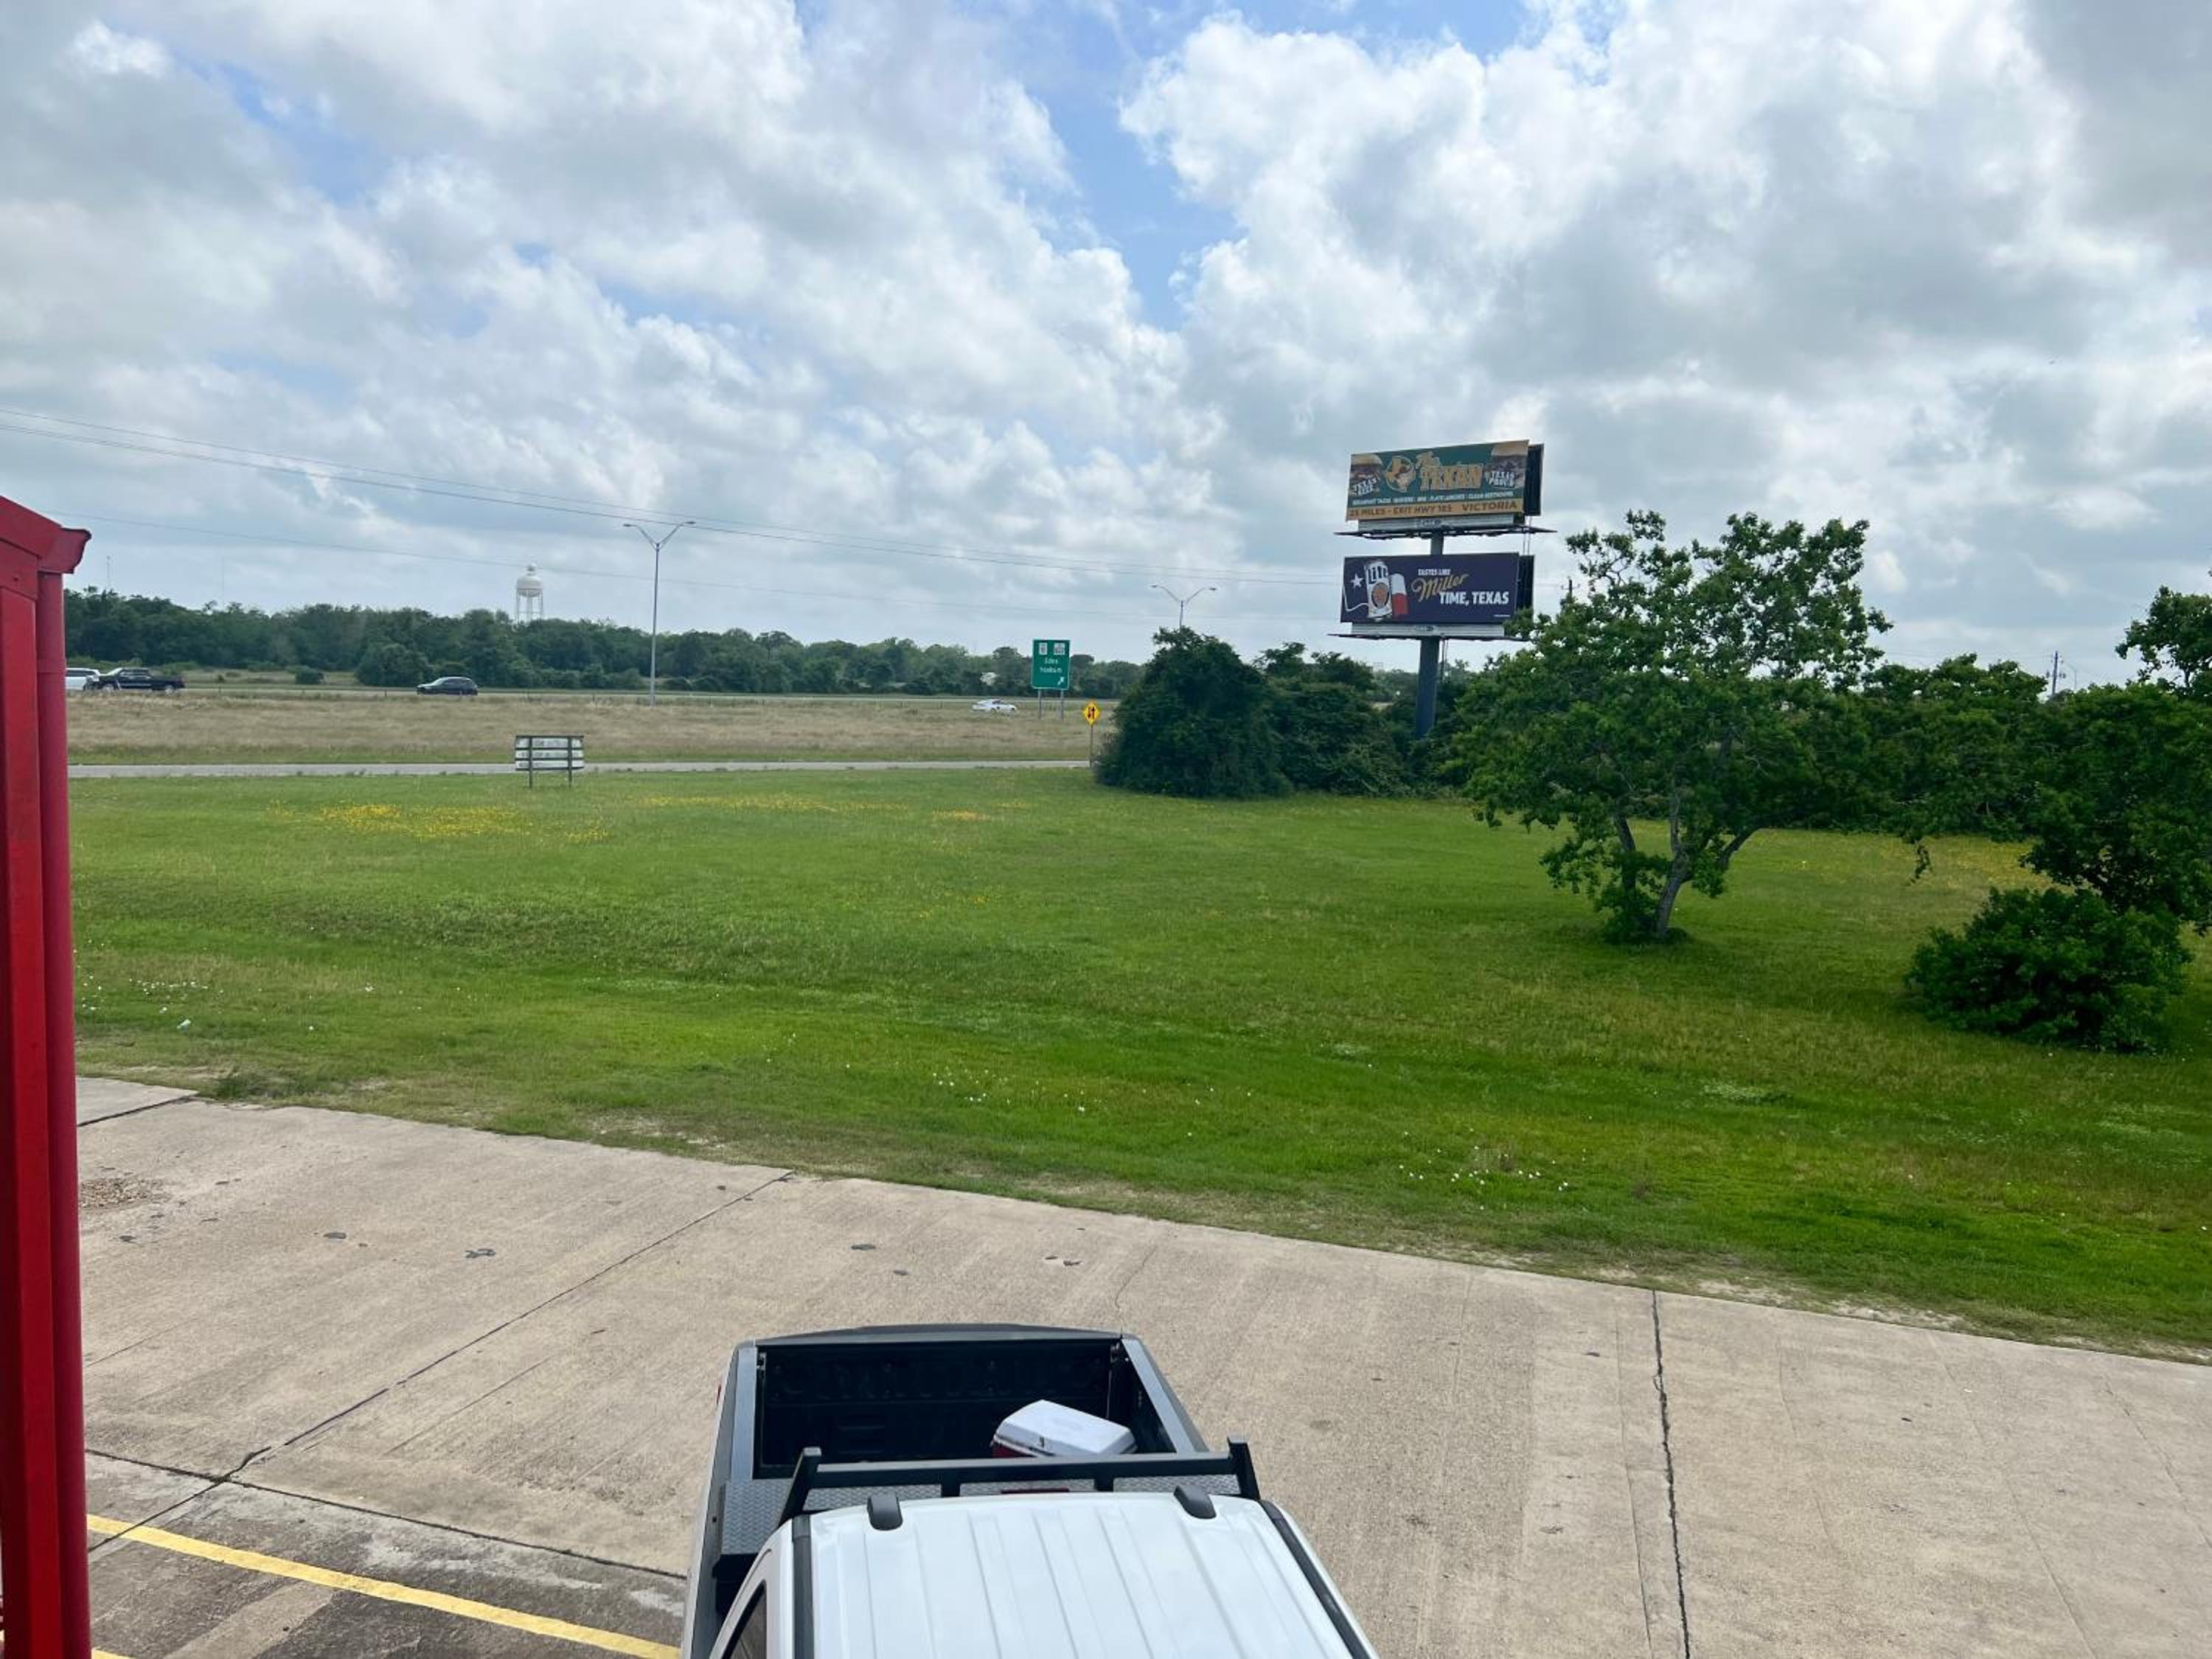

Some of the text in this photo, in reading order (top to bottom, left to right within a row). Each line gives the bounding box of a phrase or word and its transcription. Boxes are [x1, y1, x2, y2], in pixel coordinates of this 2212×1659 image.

[1415, 505, 1436, 514] HWY
[1462, 501, 1518, 511] VICTORIA
[1411, 573, 1469, 602] Miller
[1439, 591, 1509, 606] TIME, TEXAS
